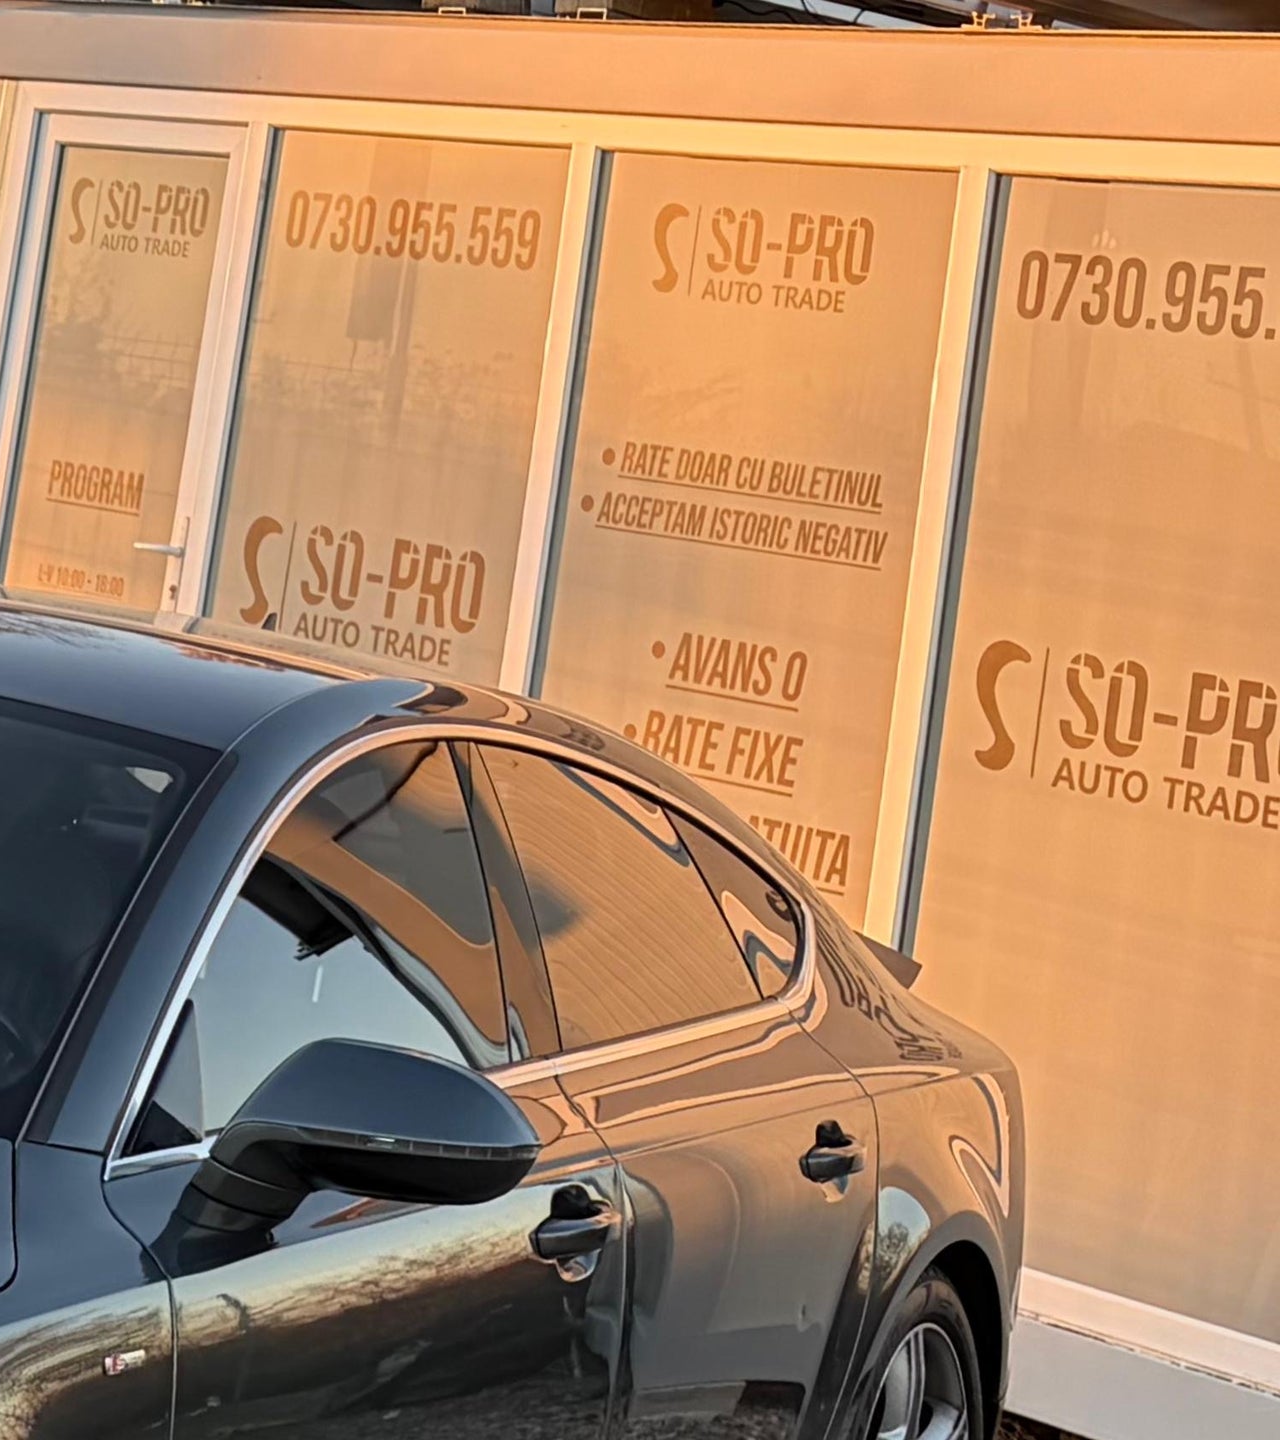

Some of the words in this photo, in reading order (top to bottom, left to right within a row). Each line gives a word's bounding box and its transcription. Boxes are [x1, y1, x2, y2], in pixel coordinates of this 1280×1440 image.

[98, 233, 139, 256] AUTO
[143, 236, 191, 259] TRADE
[103, 179, 211, 239] SO-PRO
[284, 189, 541, 272] 0730.955.559
[705, 206, 876, 286] SO-PRO
[700, 278, 764, 306] AUTO
[771, 284, 847, 314] TRADE
[1015, 249, 1277, 341] 0730.955.
[48, 458, 146, 511] PROGRAM
[620, 440, 675, 480] RATE
[675, 448, 732, 486] DOAR
[736, 456, 765, 491] CU
[767, 459, 883, 510] BULETINUL
[596, 490, 706, 538] ACCEPTAM
[708, 506, 793, 551] ISTORIC
[793, 520, 888, 566] NEGATIV
[299, 524, 487, 634] SO-PRO
[293, 611, 361, 649] AUTO
[371, 623, 453, 667] TRADE
[667, 631, 777, 698] AVANS
[642, 709, 724, 773] RATE
[726, 725, 804, 789] FIXE
[1058, 651, 1280, 784] SO-PR
[1050, 756, 1149, 803] AUTO
[1163, 775, 1280, 831] TRADE
